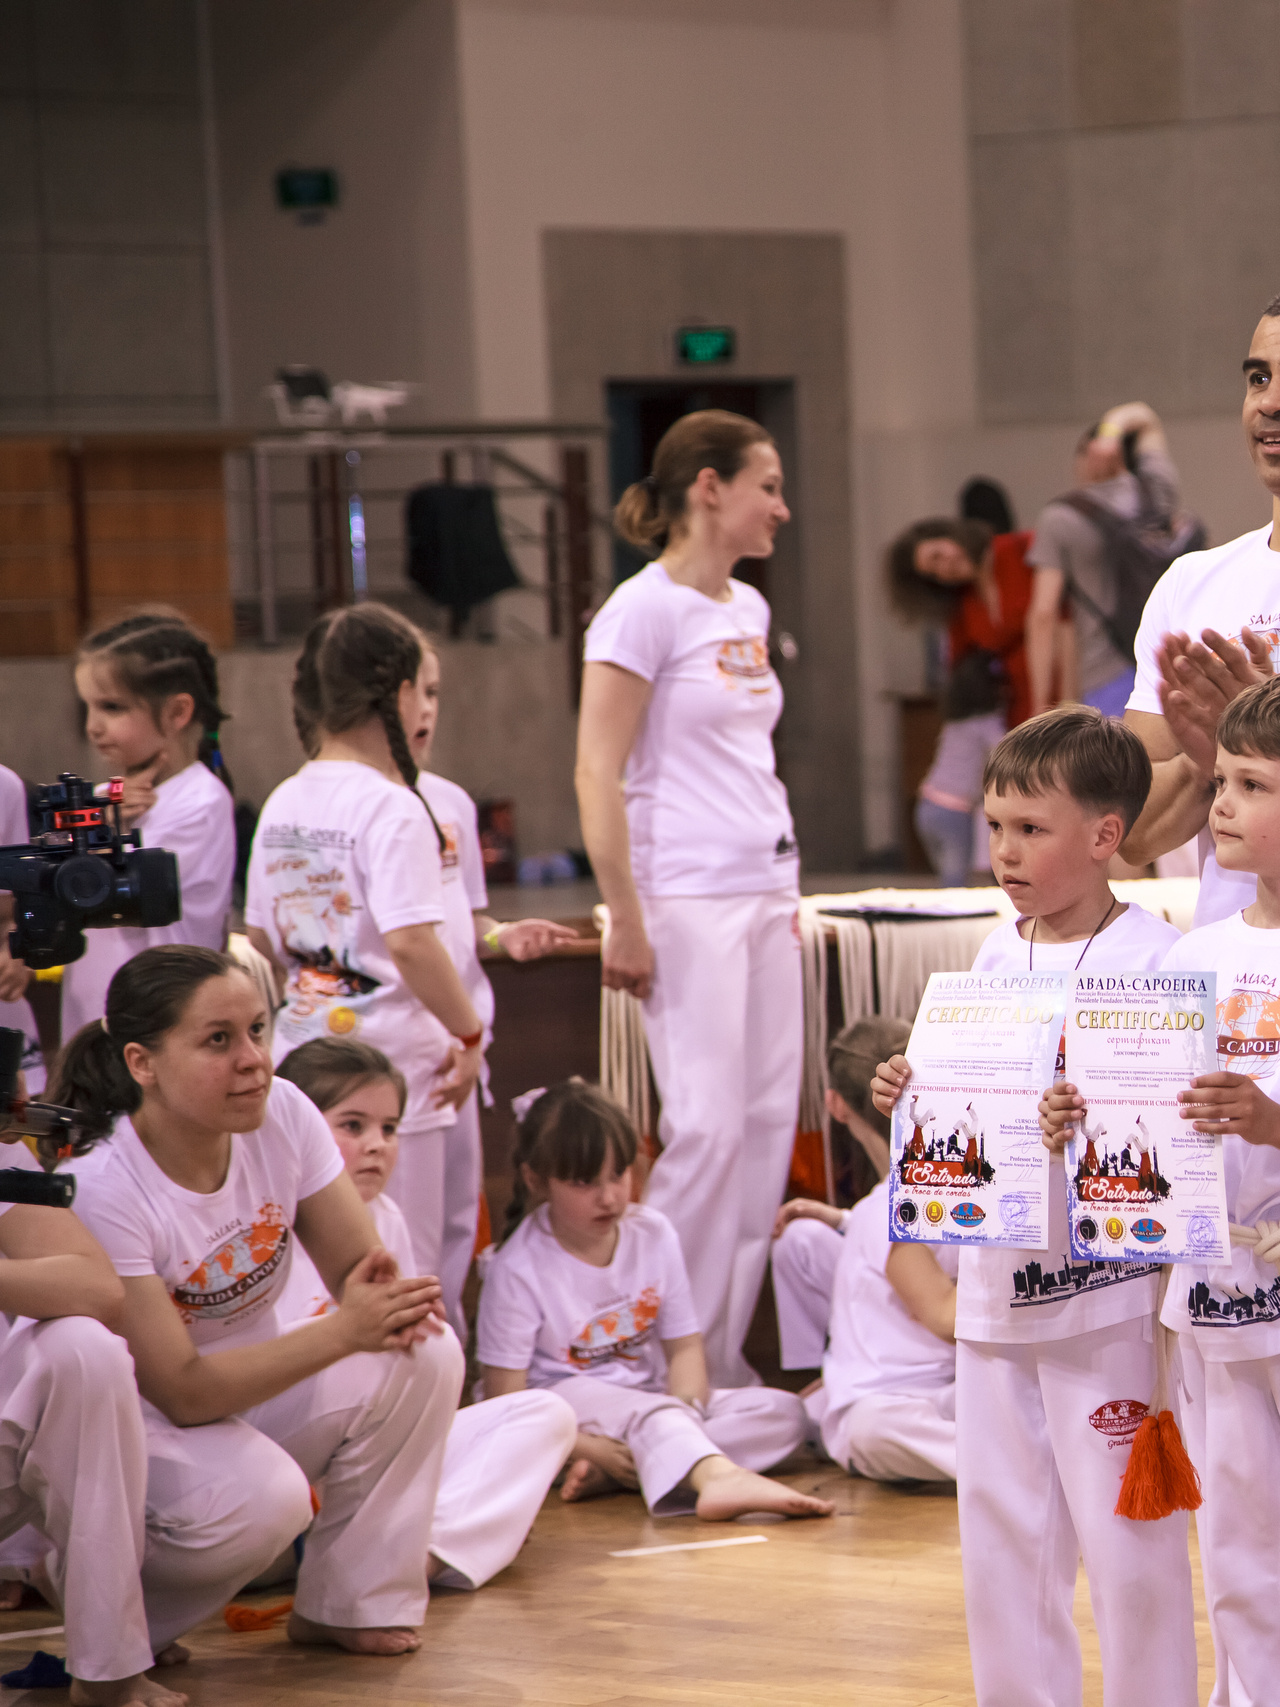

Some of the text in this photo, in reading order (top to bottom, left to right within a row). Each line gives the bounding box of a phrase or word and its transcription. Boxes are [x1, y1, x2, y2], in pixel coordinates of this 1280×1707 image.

[935, 975, 1063, 989] ABADÁ-CAPOEIRA
[1076, 974, 1207, 992] ABADÁ-CAPOEIRA
[1075, 996, 1099, 1004] Presidente
[926, 1006, 1054, 1024] CERTIFICADO
[1075, 1009, 1205, 1031] CERTIFICADO
[1107, 1032, 1170, 1049] сертификат
[912, 1162, 977, 1186] Batizado
[912, 1187, 931, 1195] troca
[934, 1188, 943, 1196] de
[946, 1189, 971, 1197] cordas
[1088, 1178, 1154, 1202] Batizado
[1090, 1203, 1109, 1212] troca
[1112, 1204, 1121, 1212] de
[1124, 1205, 1150, 1213] cordas
